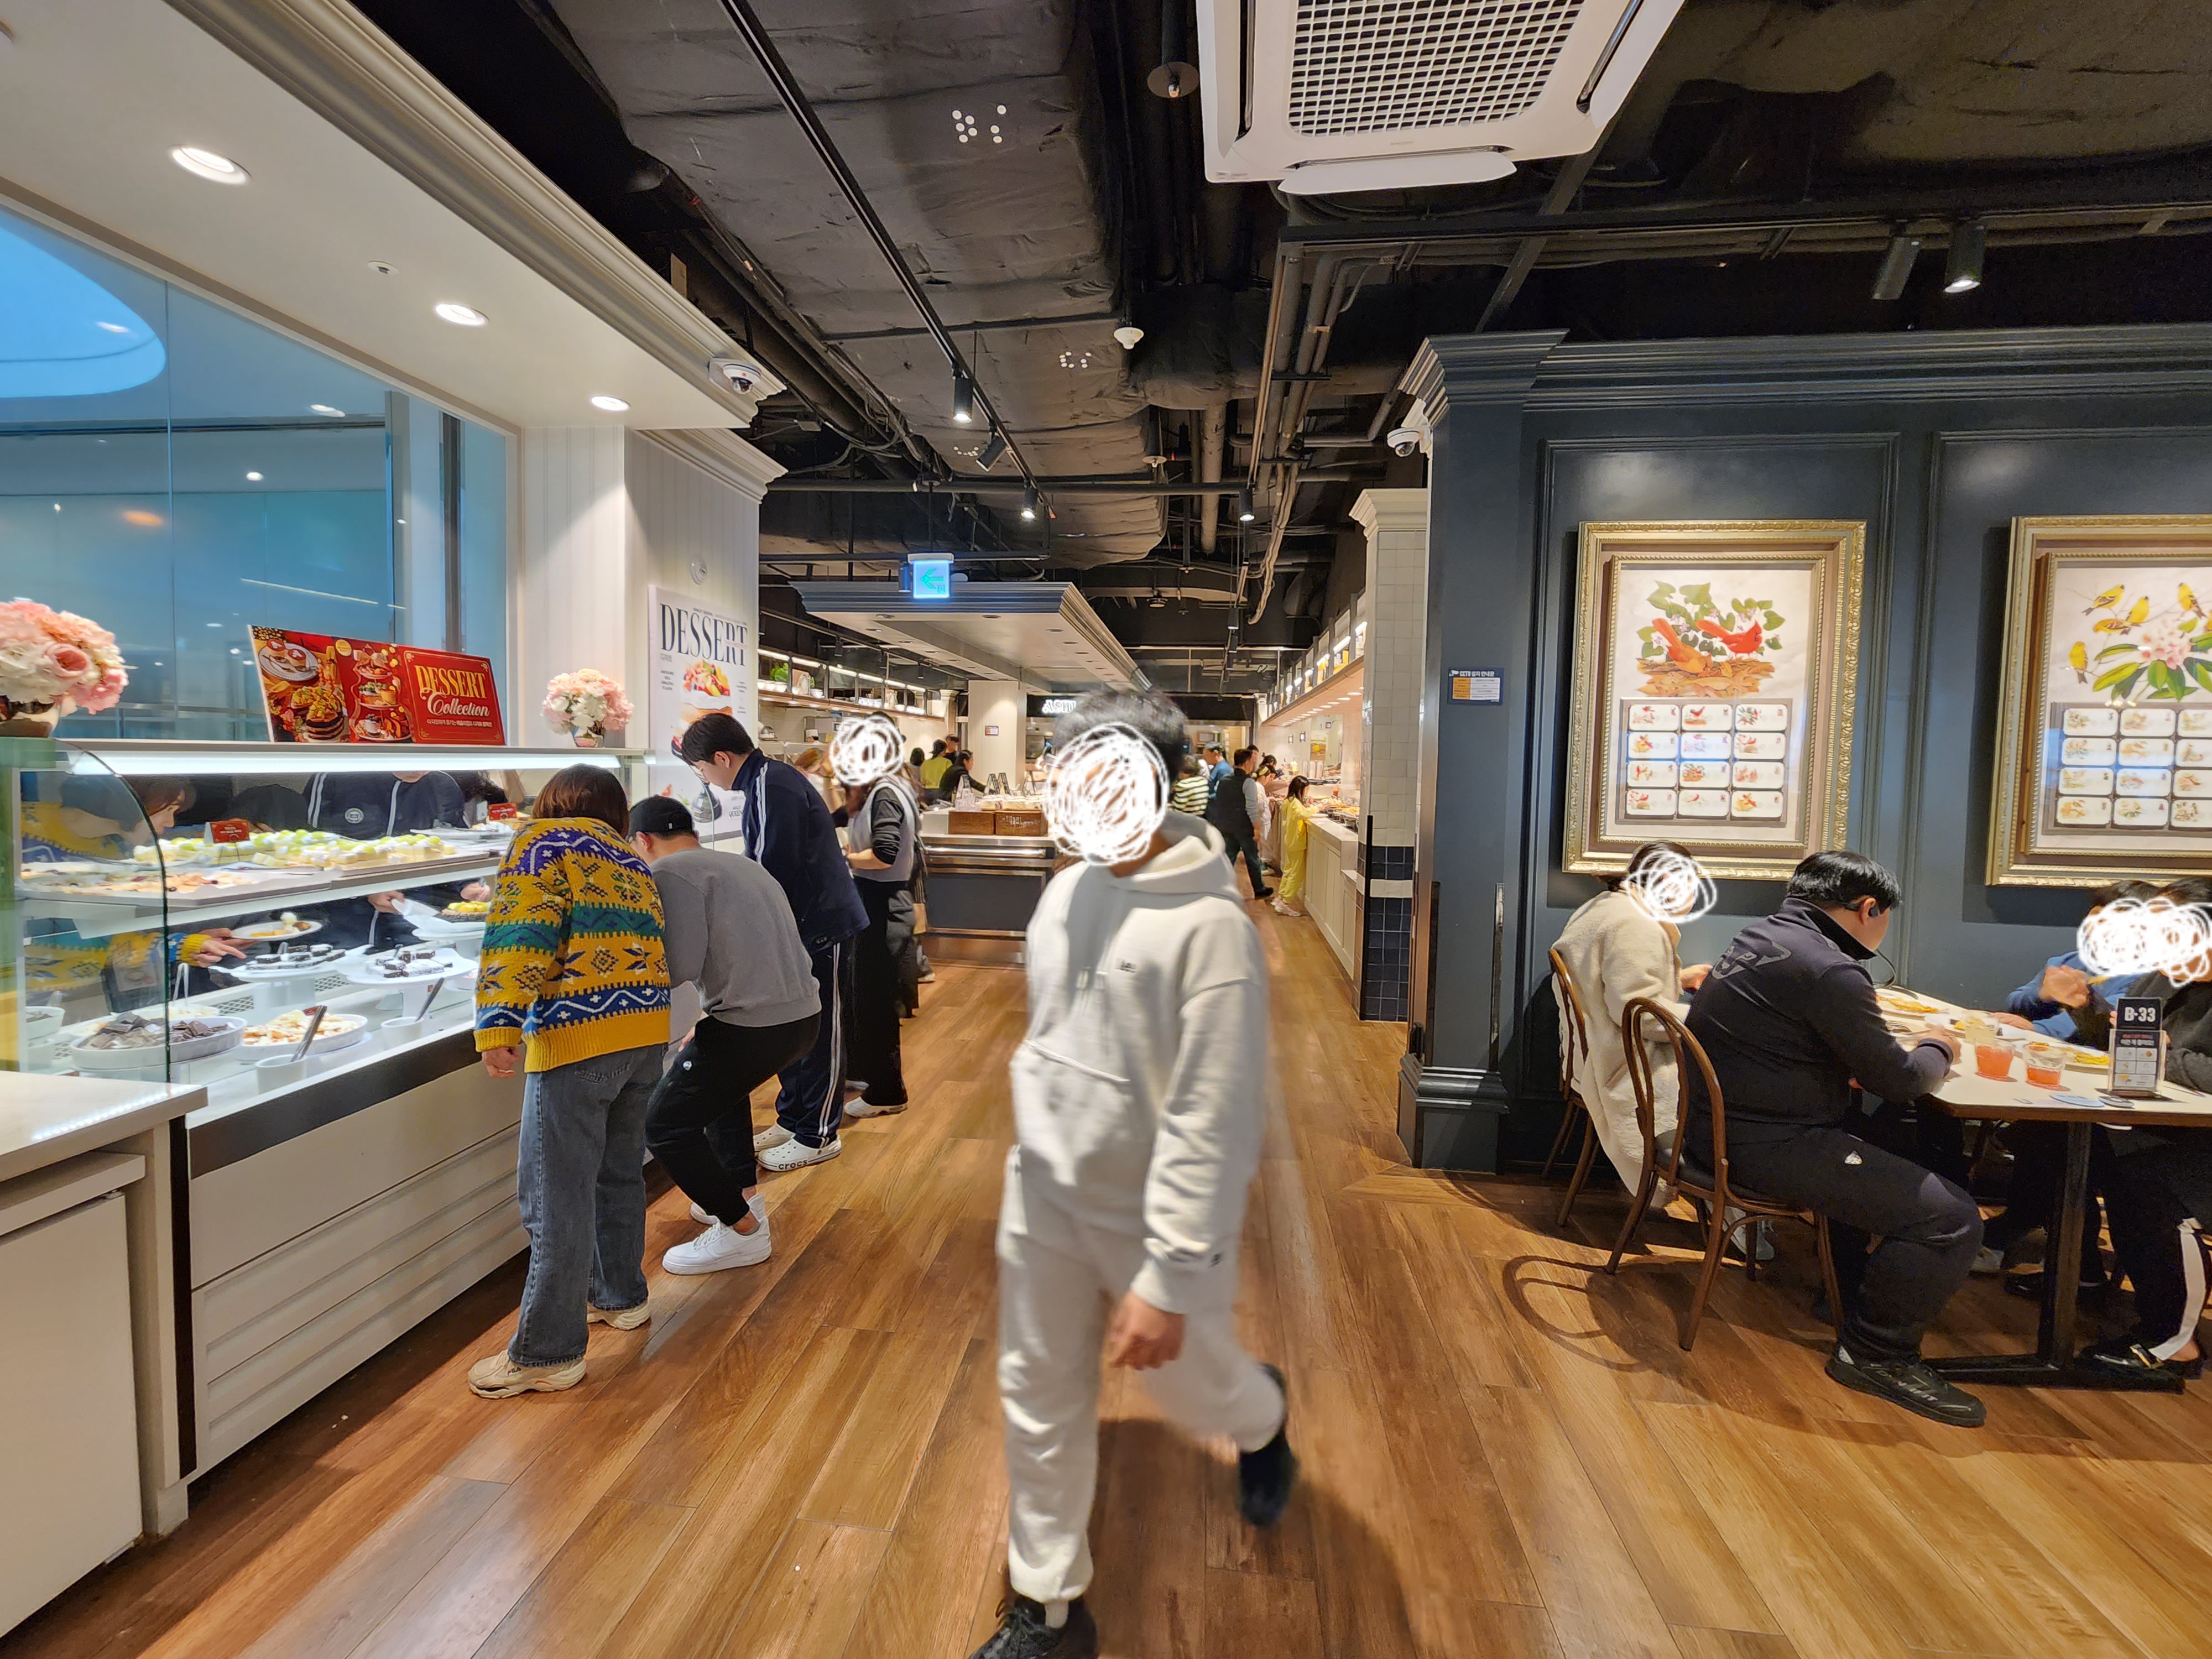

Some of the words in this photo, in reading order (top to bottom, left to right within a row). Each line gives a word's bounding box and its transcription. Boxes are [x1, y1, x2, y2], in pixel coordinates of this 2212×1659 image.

[660, 603, 748, 666] DESSERT
[414, 665, 487, 698] DESSERT
[420, 687, 491, 716] Collection
[2124, 1006, 2156, 1022] B-33
[778, 1160, 807, 1170] crocs
